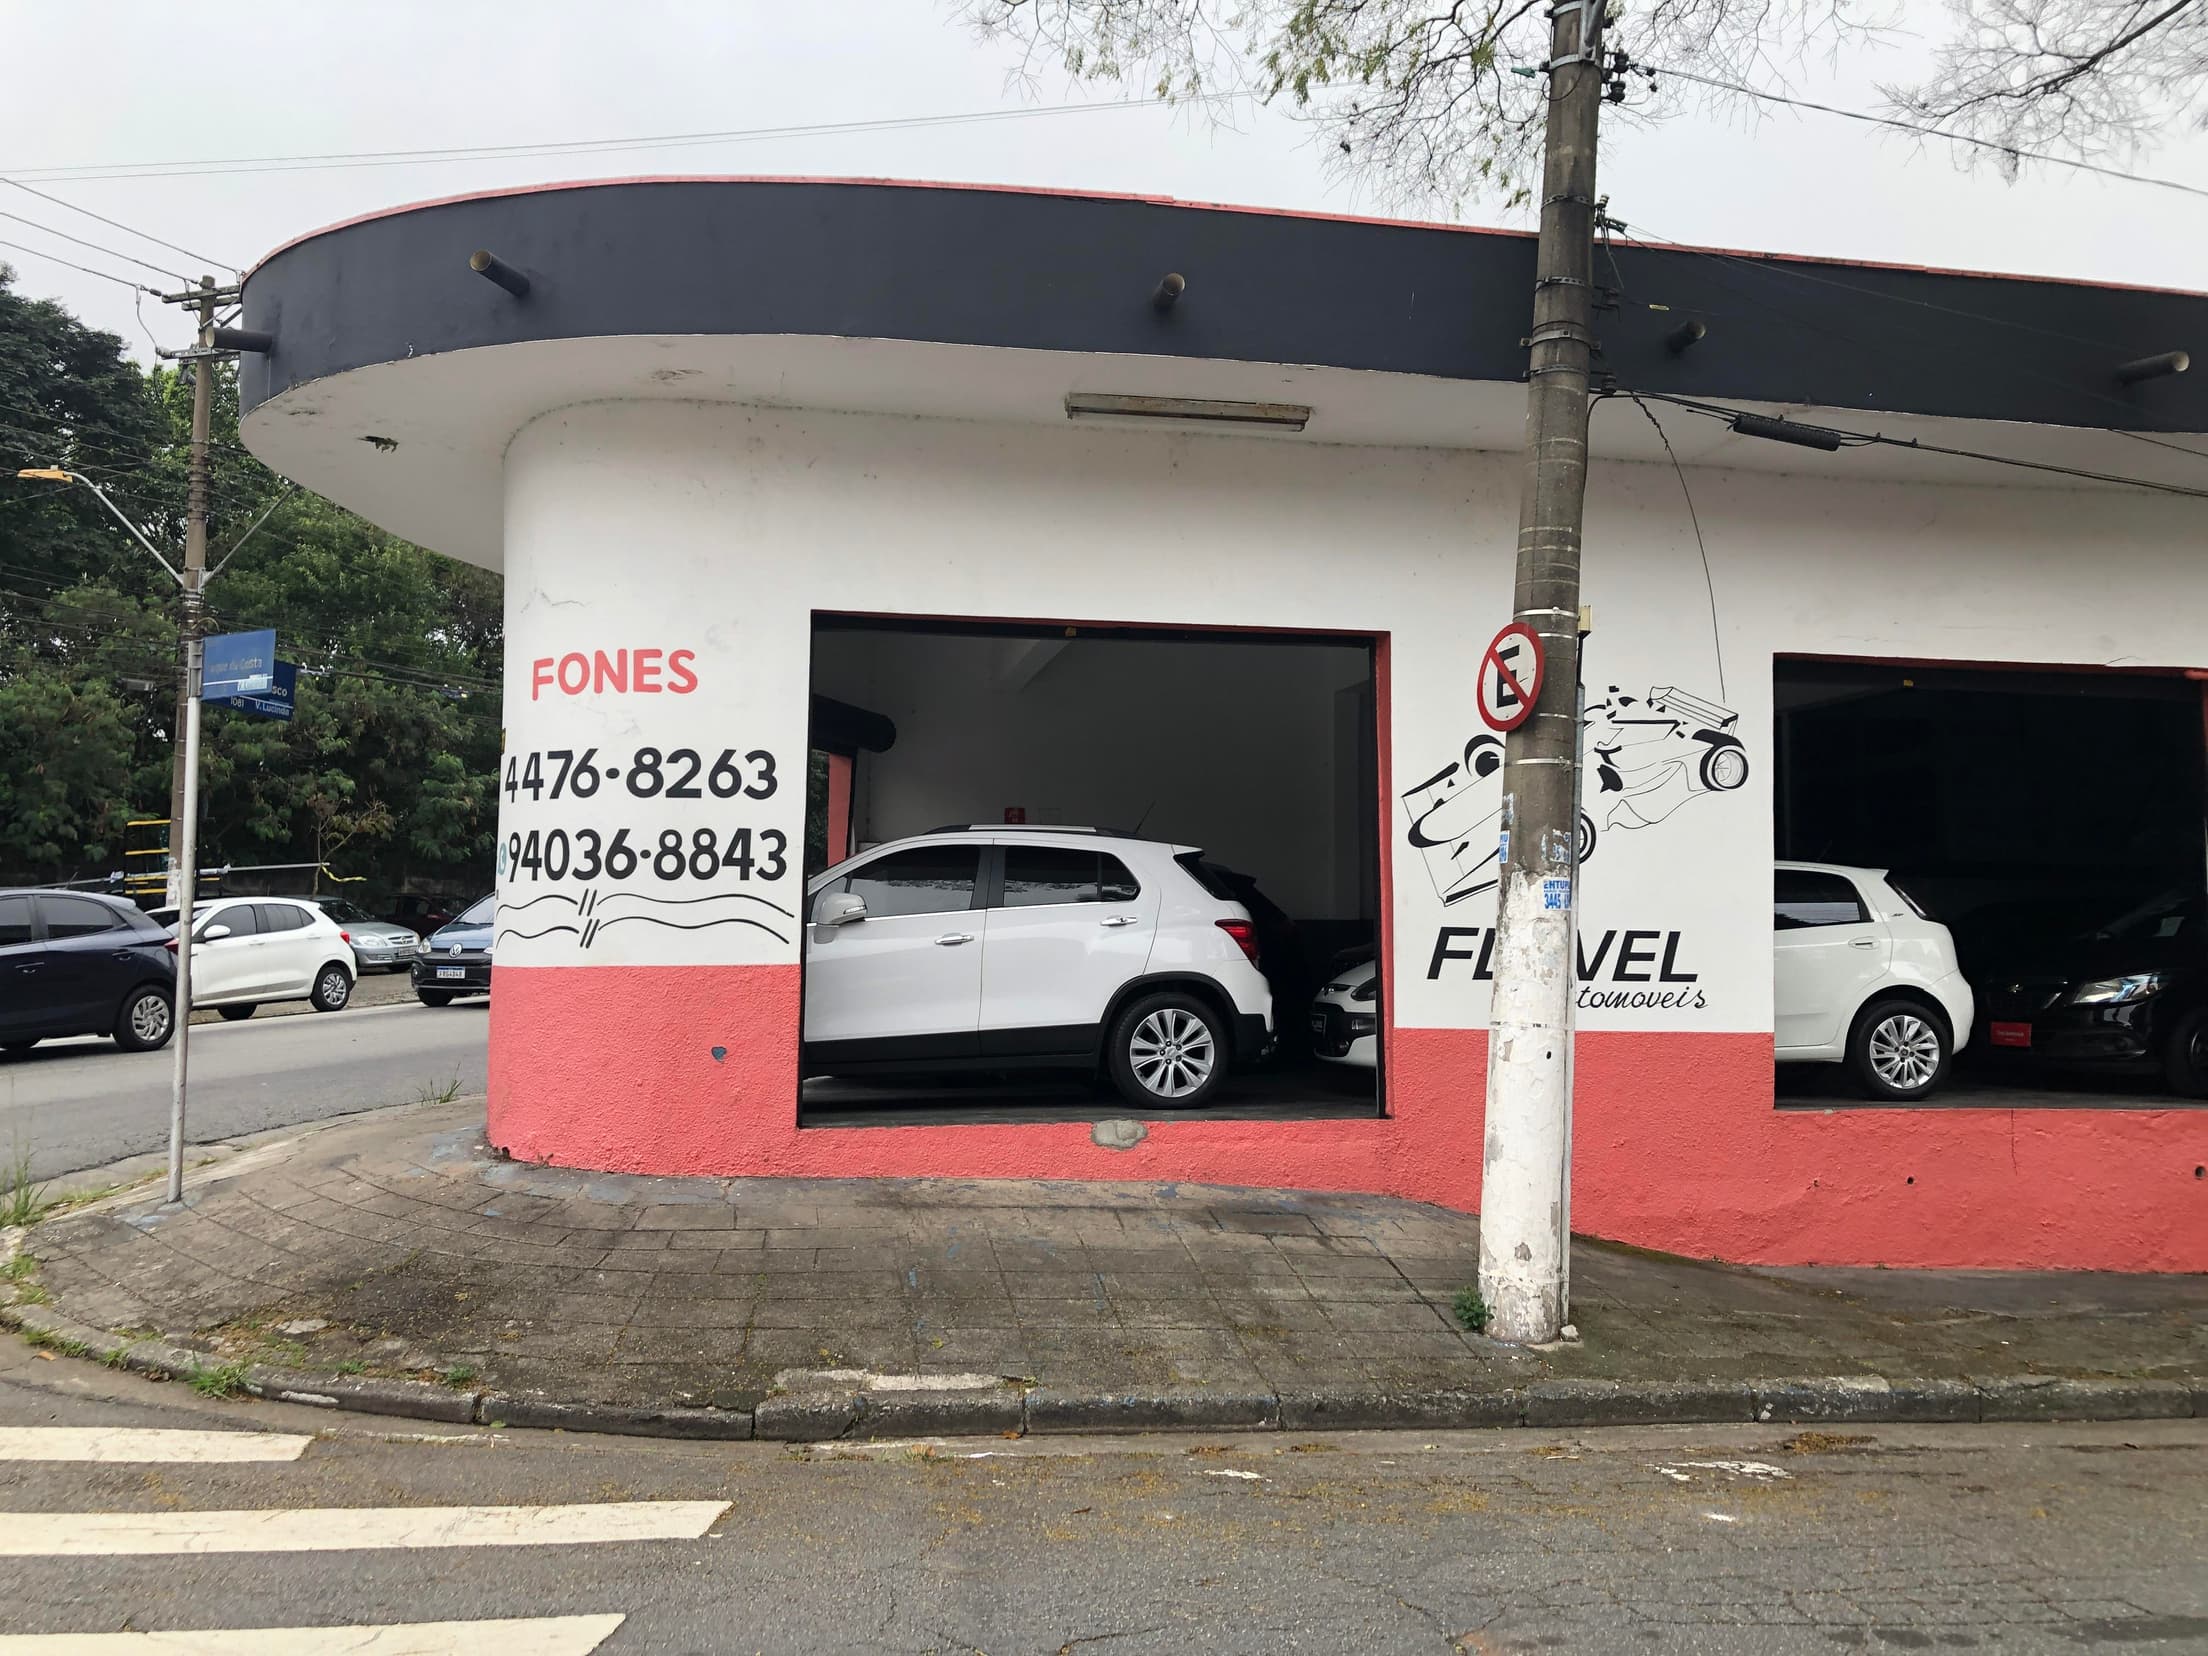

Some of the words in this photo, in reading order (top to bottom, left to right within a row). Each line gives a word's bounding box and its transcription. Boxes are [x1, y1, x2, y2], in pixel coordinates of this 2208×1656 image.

[532, 648, 698, 701] FONES
[1497, 644, 1520, 708] E
[1427, 926, 1699, 983] FLVEL
[1576, 986, 1708, 1009] tomoveis
